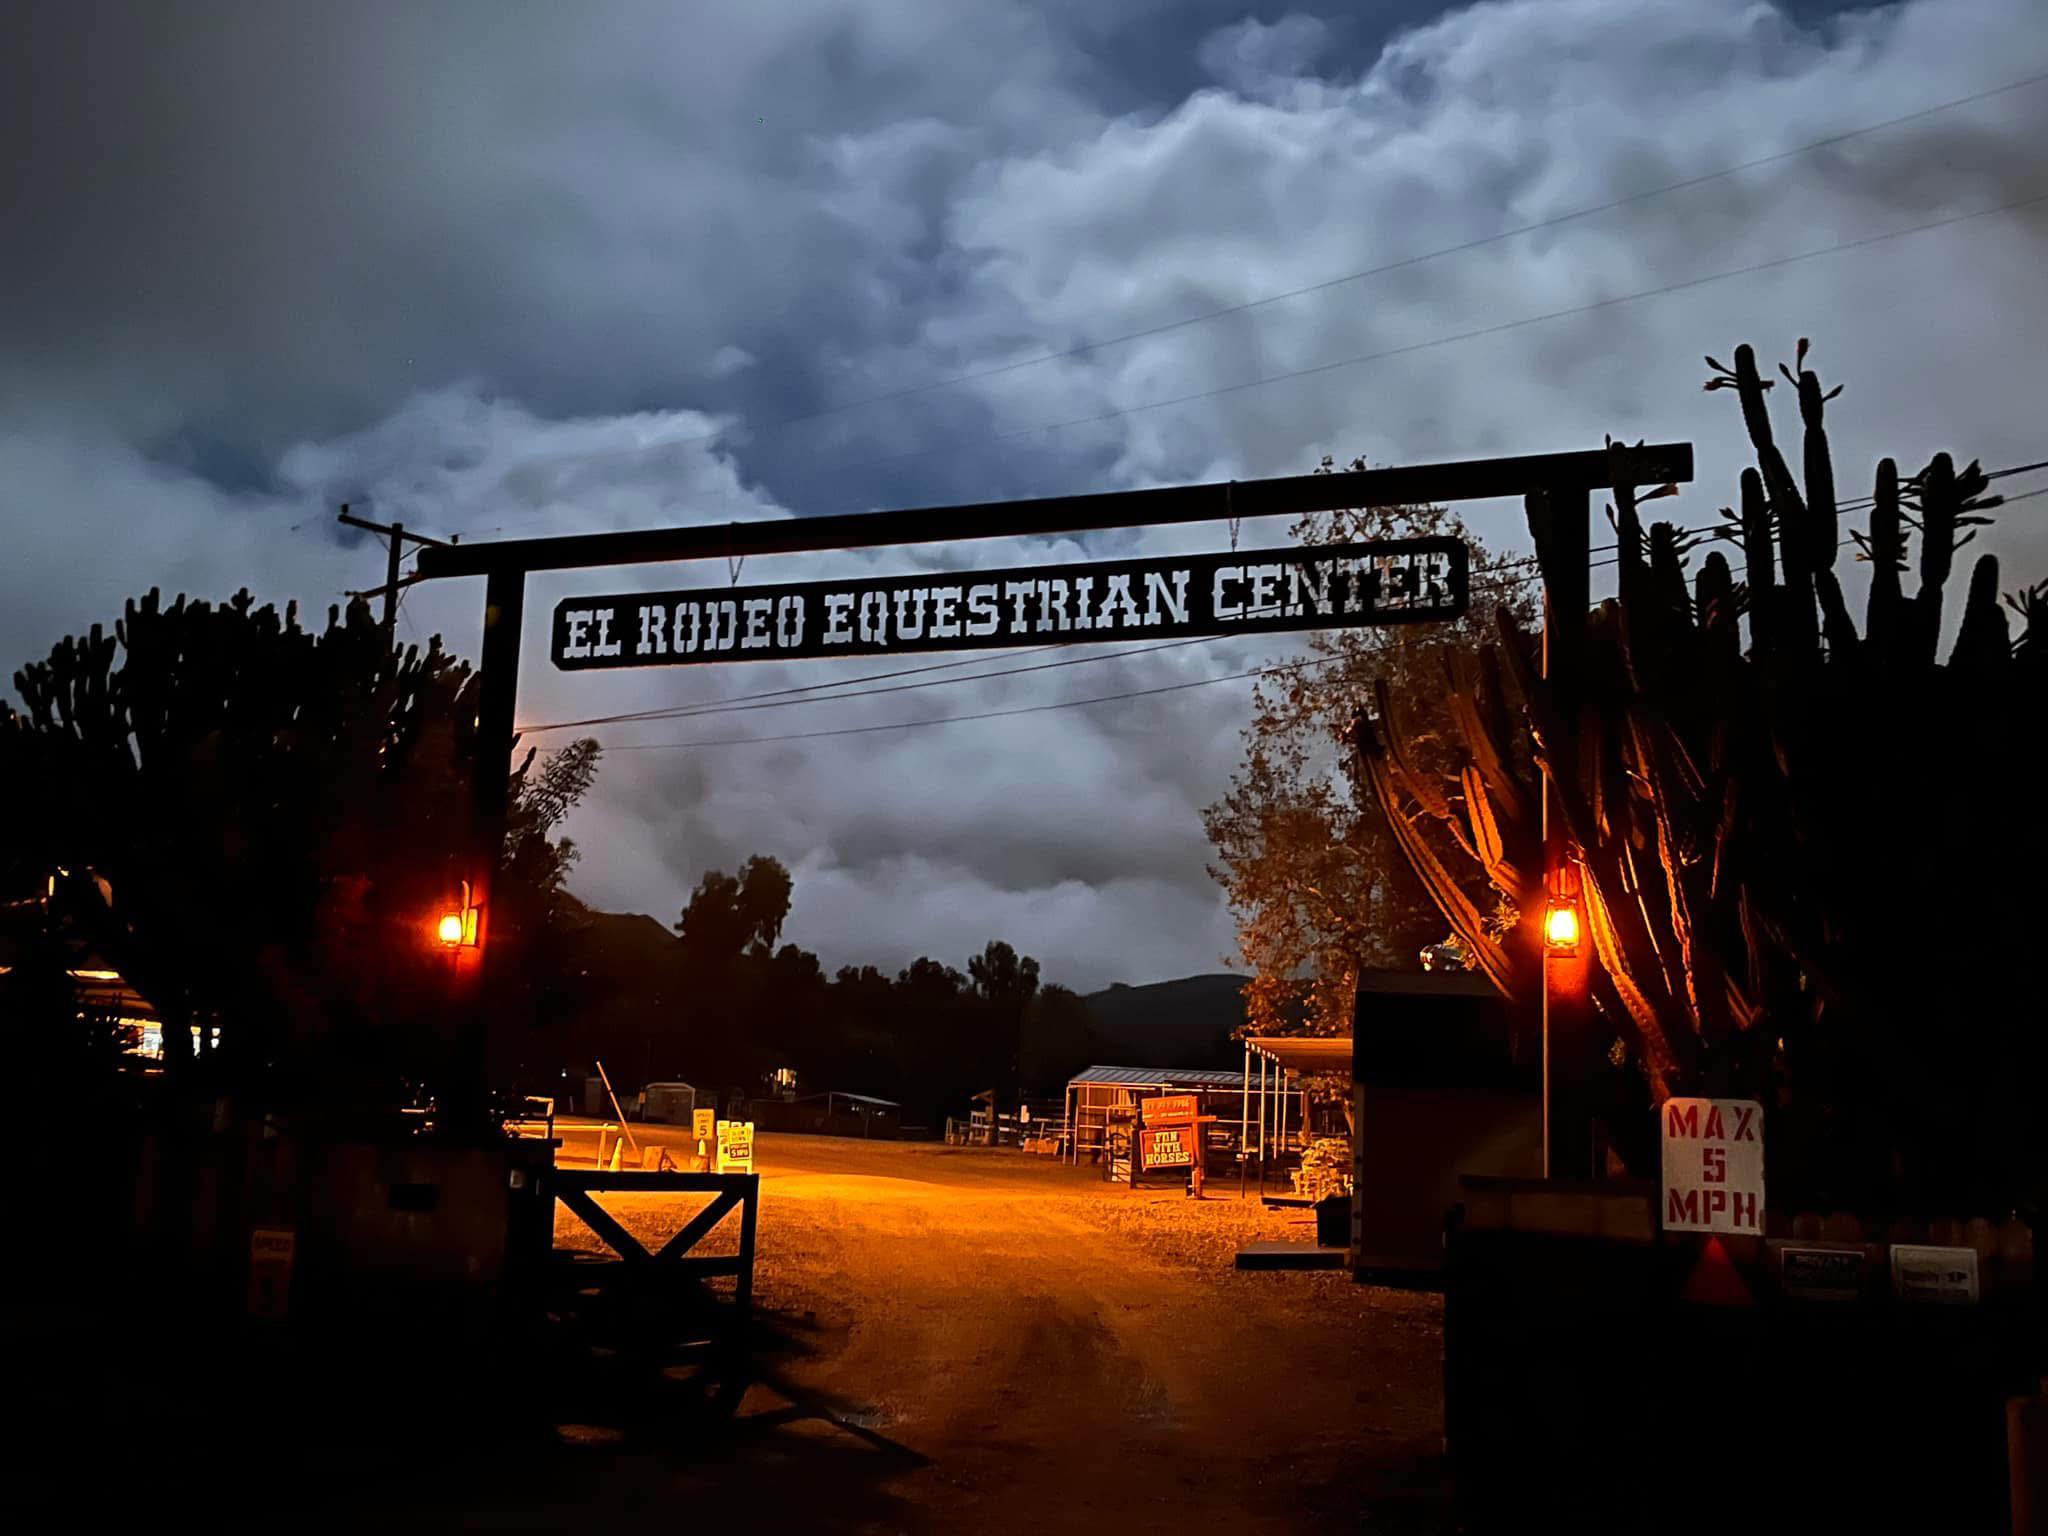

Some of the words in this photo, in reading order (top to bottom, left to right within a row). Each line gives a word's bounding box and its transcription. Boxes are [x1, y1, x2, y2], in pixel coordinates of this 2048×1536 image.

[563, 608, 621, 659] EL
[636, 596, 806, 655] RODEO
[822, 569, 1191, 646] EQUESTRIAN
[1211, 552, 1455, 621] CENTER
[699, 1125, 707, 1136] 5
[1668, 1105, 1754, 1142] MAX
[1145, 1151, 1190, 1165] HORSES
[1153, 1142, 1181, 1153] WITH
[1703, 1148, 1725, 1183] 5
[1668, 1187, 1755, 1228] MPH
